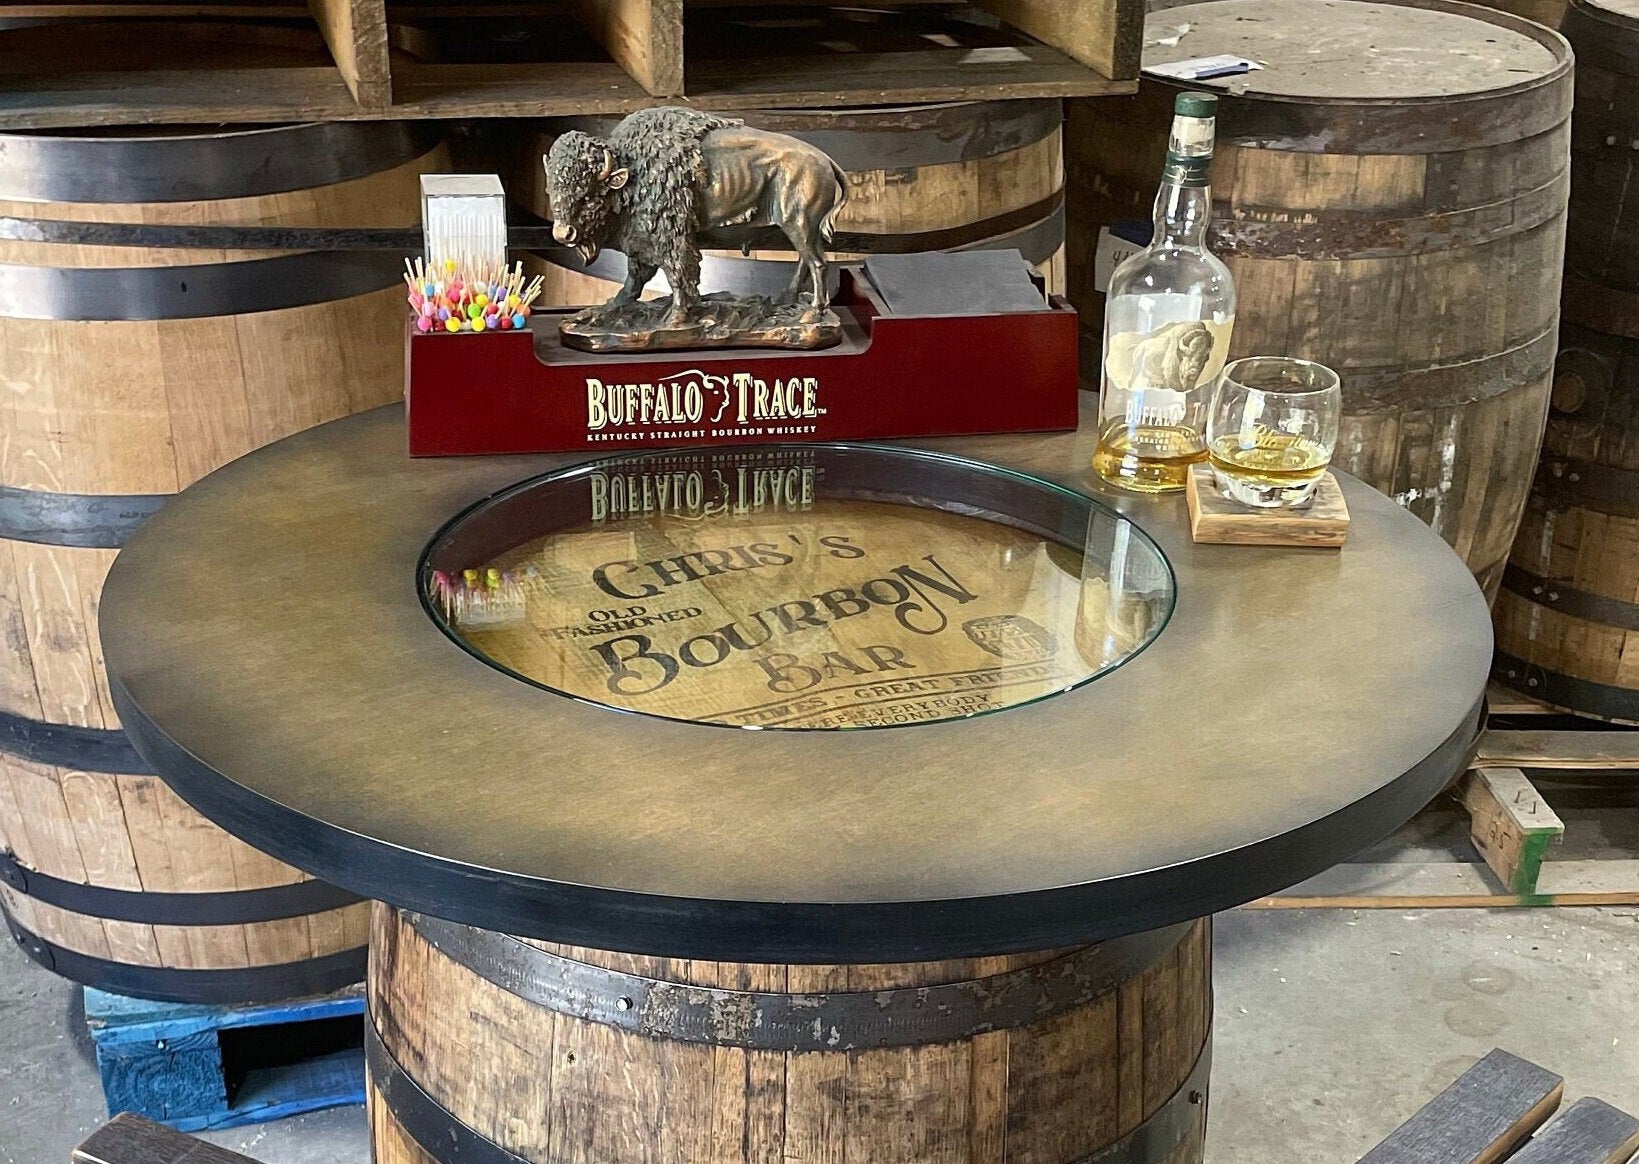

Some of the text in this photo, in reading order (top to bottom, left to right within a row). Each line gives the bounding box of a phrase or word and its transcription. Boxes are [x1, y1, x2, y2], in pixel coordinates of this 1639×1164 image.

[586, 379, 704, 430] BUFFALO
[733, 373, 817, 424] TRACE
[587, 425, 817, 442] KENTUCKY STRAIGHT BOURBON WHISKEY
[592, 535, 865, 599] CHRIS'S
[552, 606, 703, 640] FASHIONED
[587, 605, 647, 623] OLD
[588, 554, 979, 696] BOURBON
[753, 645, 917, 693] BAR
[735, 697, 828, 725] TIMES
[854, 678, 942, 699] GREAT
